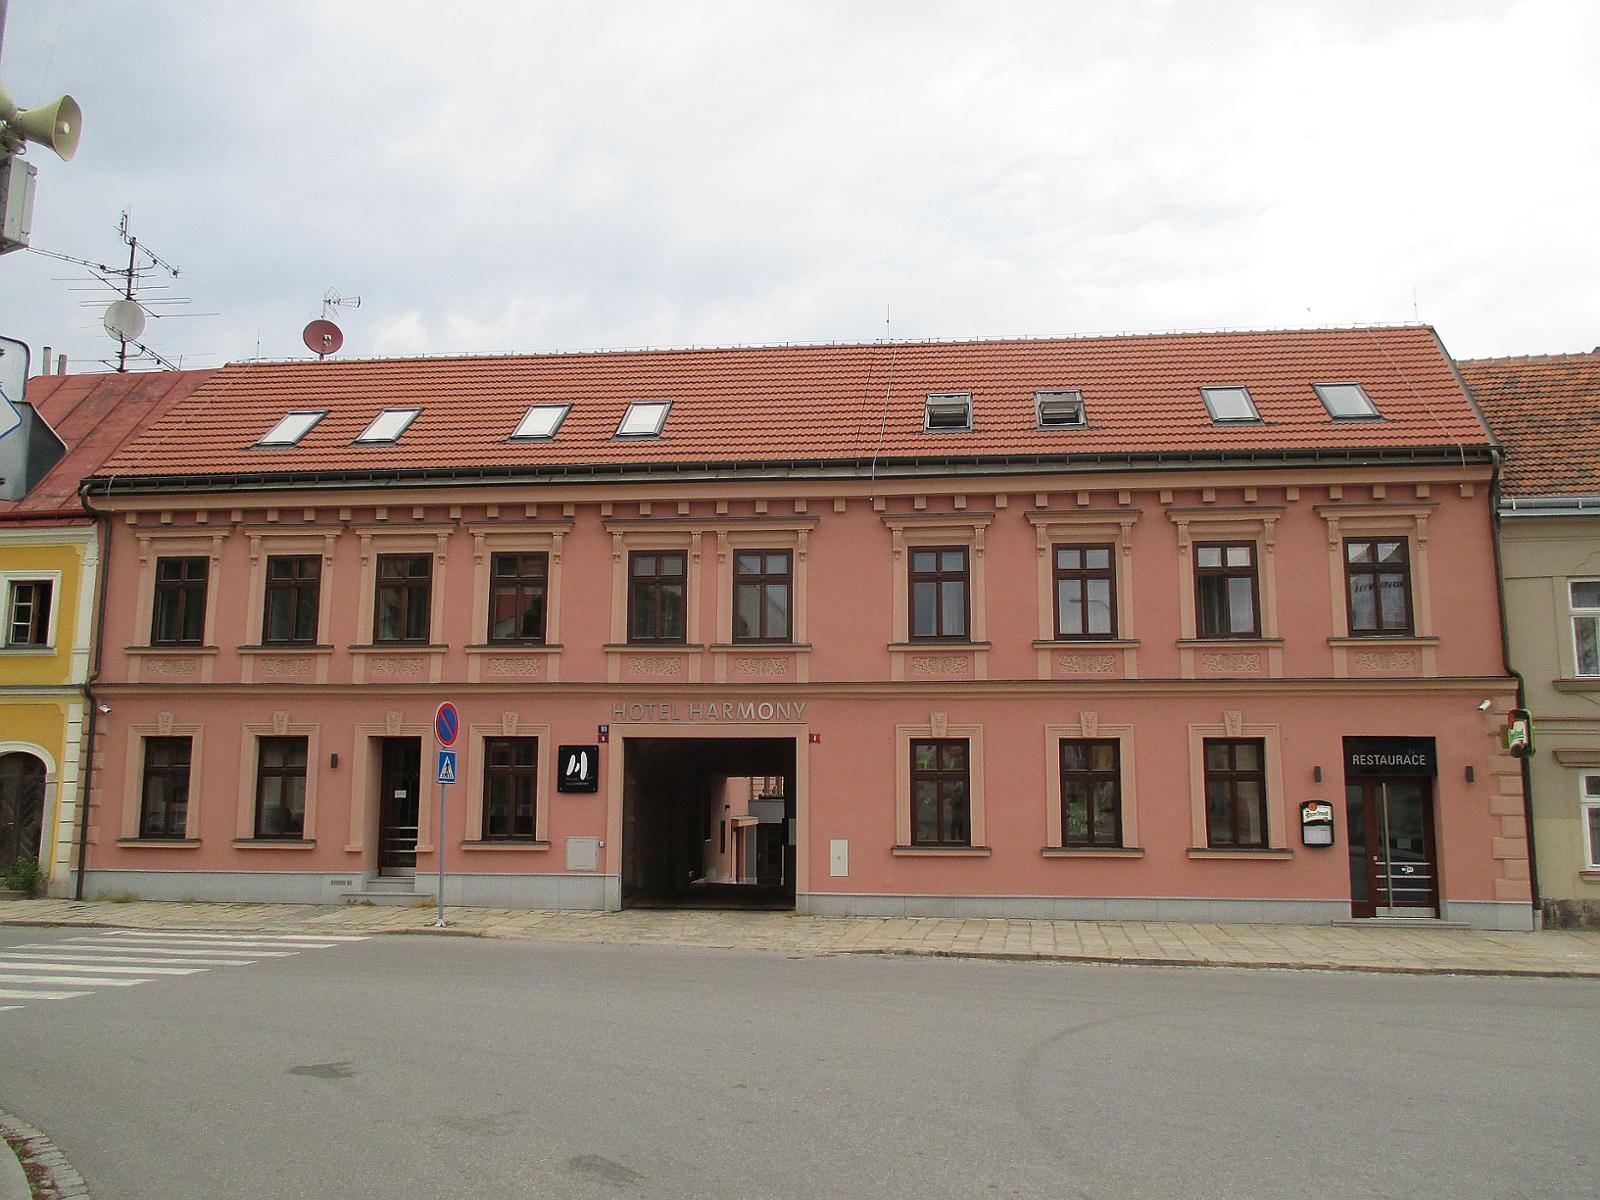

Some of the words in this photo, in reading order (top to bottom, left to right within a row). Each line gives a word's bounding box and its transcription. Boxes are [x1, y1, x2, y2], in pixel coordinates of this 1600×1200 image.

[611, 702, 680, 721] HOTEL
[688, 702, 807, 721] HARMONY
[1352, 754, 1426, 766] RESTAURACE
